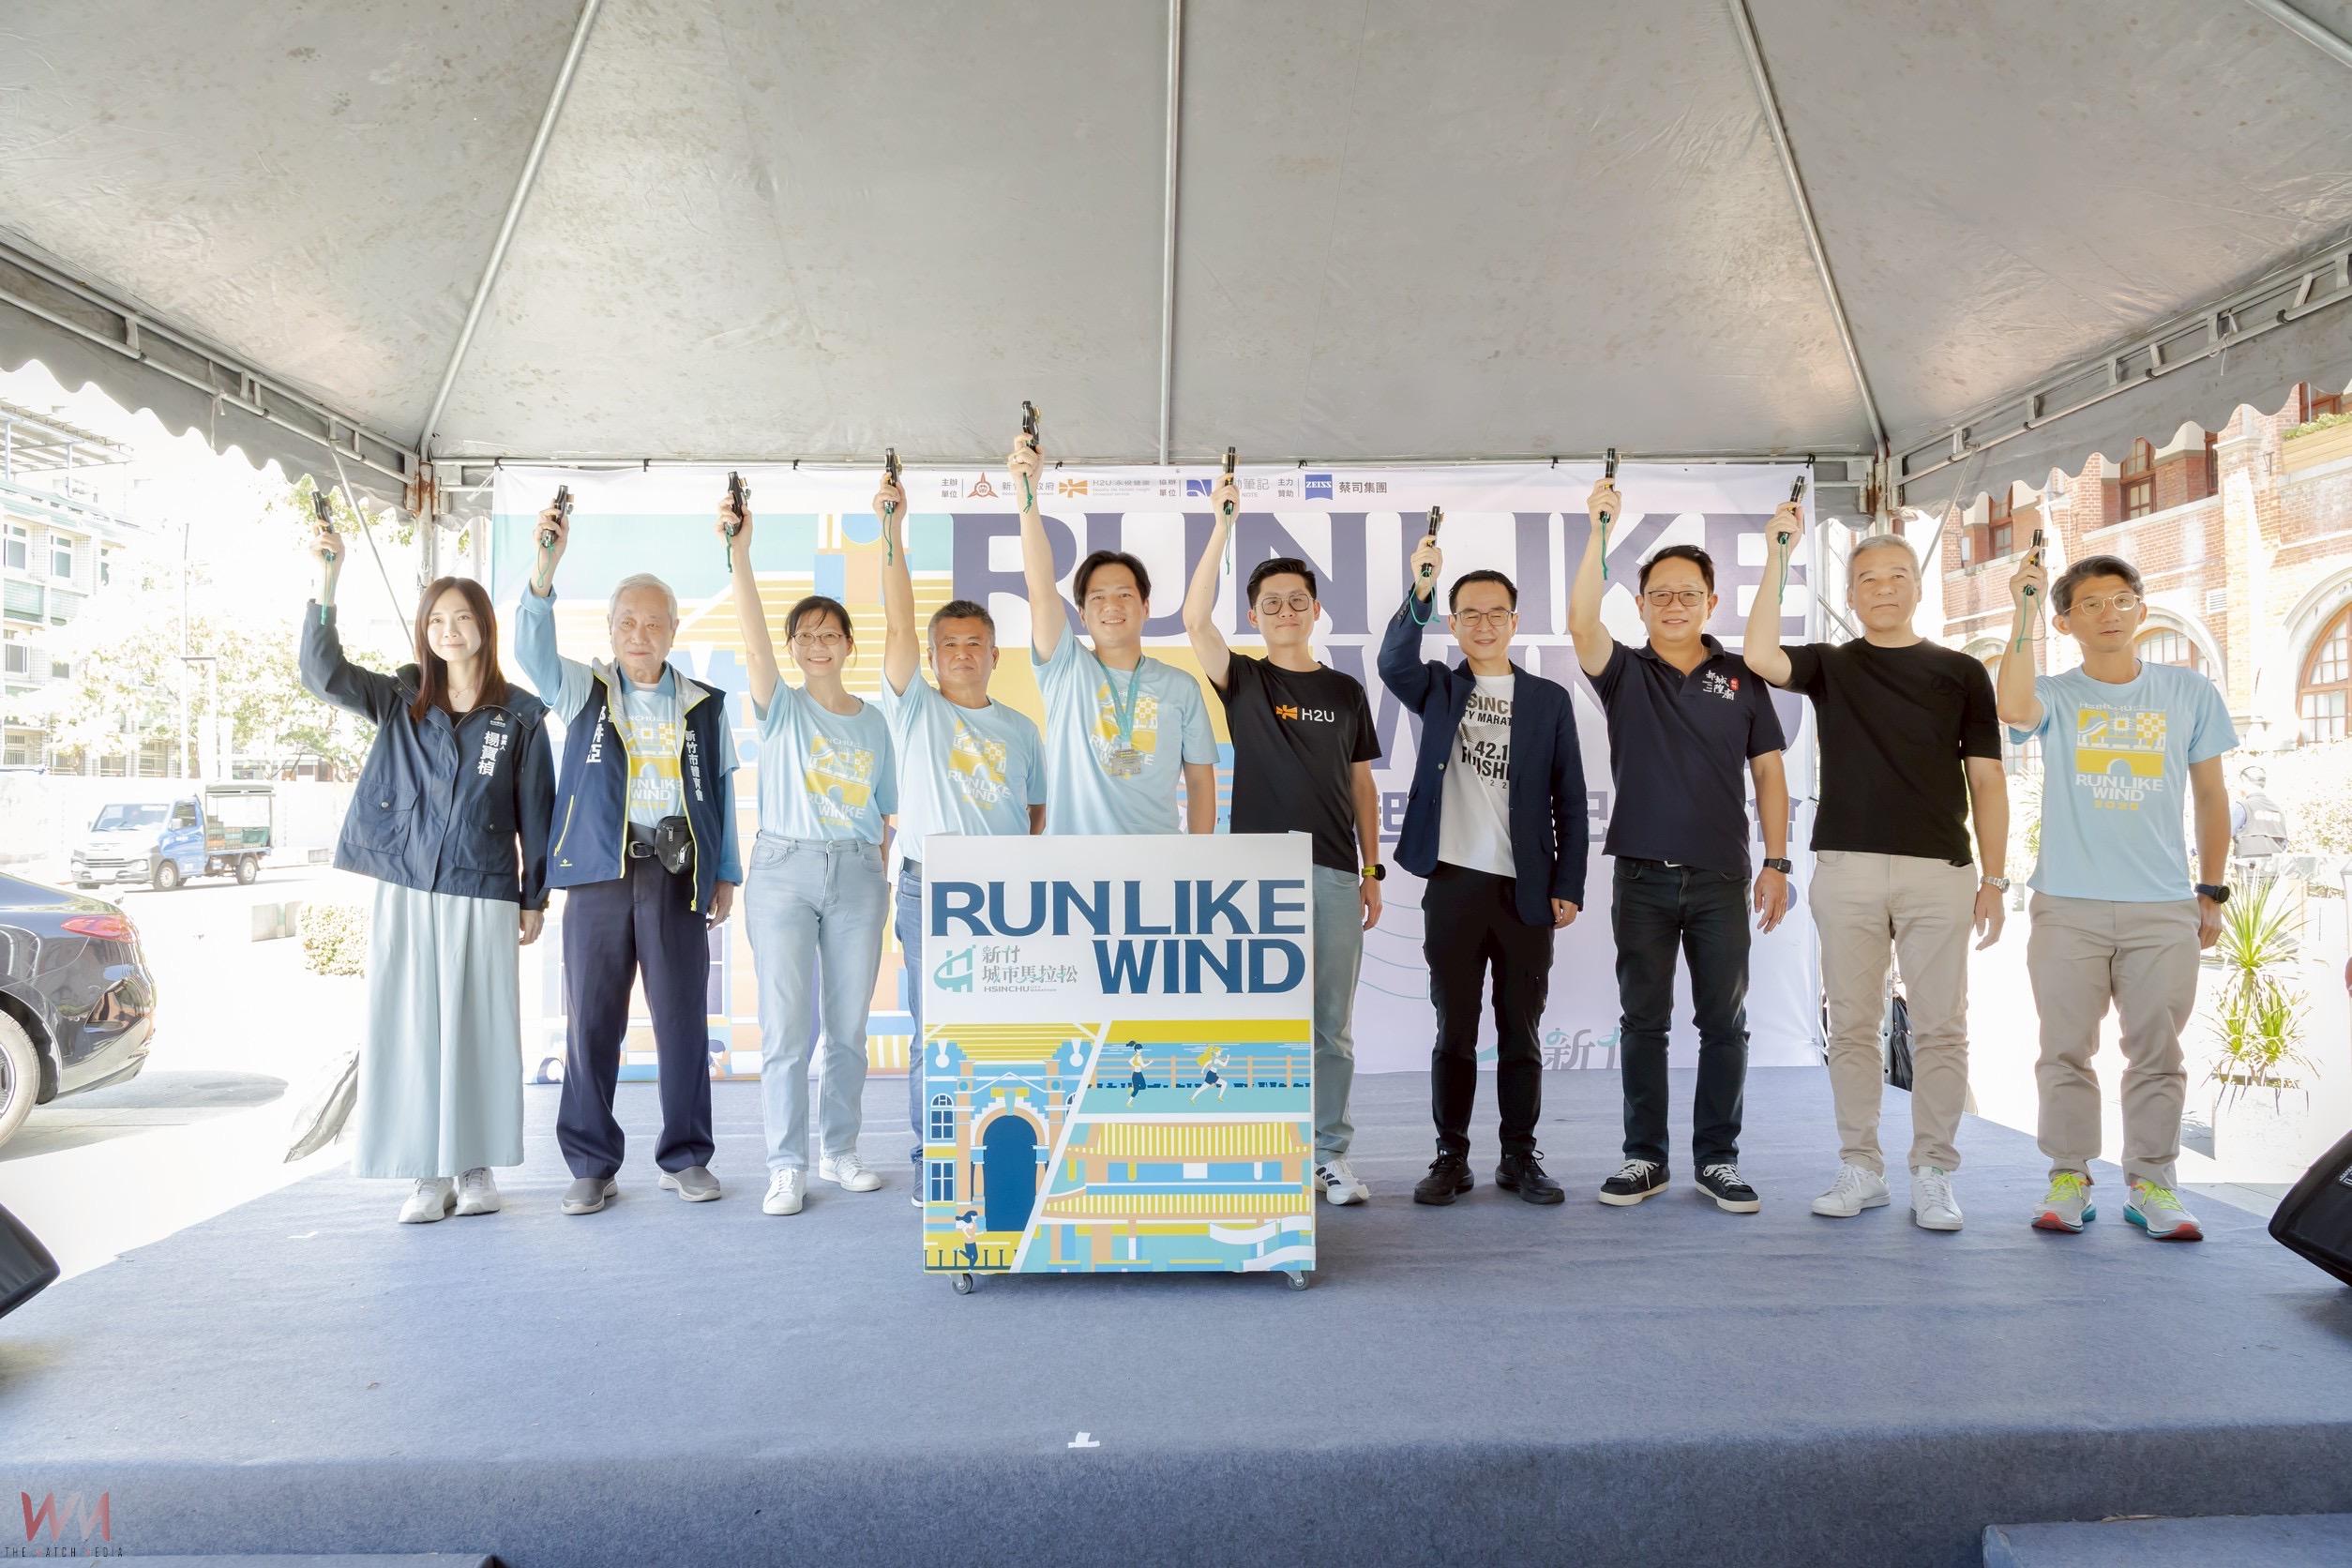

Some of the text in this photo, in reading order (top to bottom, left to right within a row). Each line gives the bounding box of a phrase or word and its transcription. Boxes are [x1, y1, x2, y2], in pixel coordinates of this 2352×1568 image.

[1277, 478, 1293, 487] 主力
[1305, 480, 1333, 490] ZEISS
[1338, 481, 1388, 493] 蔡司集團
[1302, 708, 1334, 723] H2U
[2092, 787, 2145, 802] WIND
[982, 945, 1020, 964] 新竹
[1092, 939, 1306, 994] WIND
[982, 965, 1078, 984] 城市馬拉松
